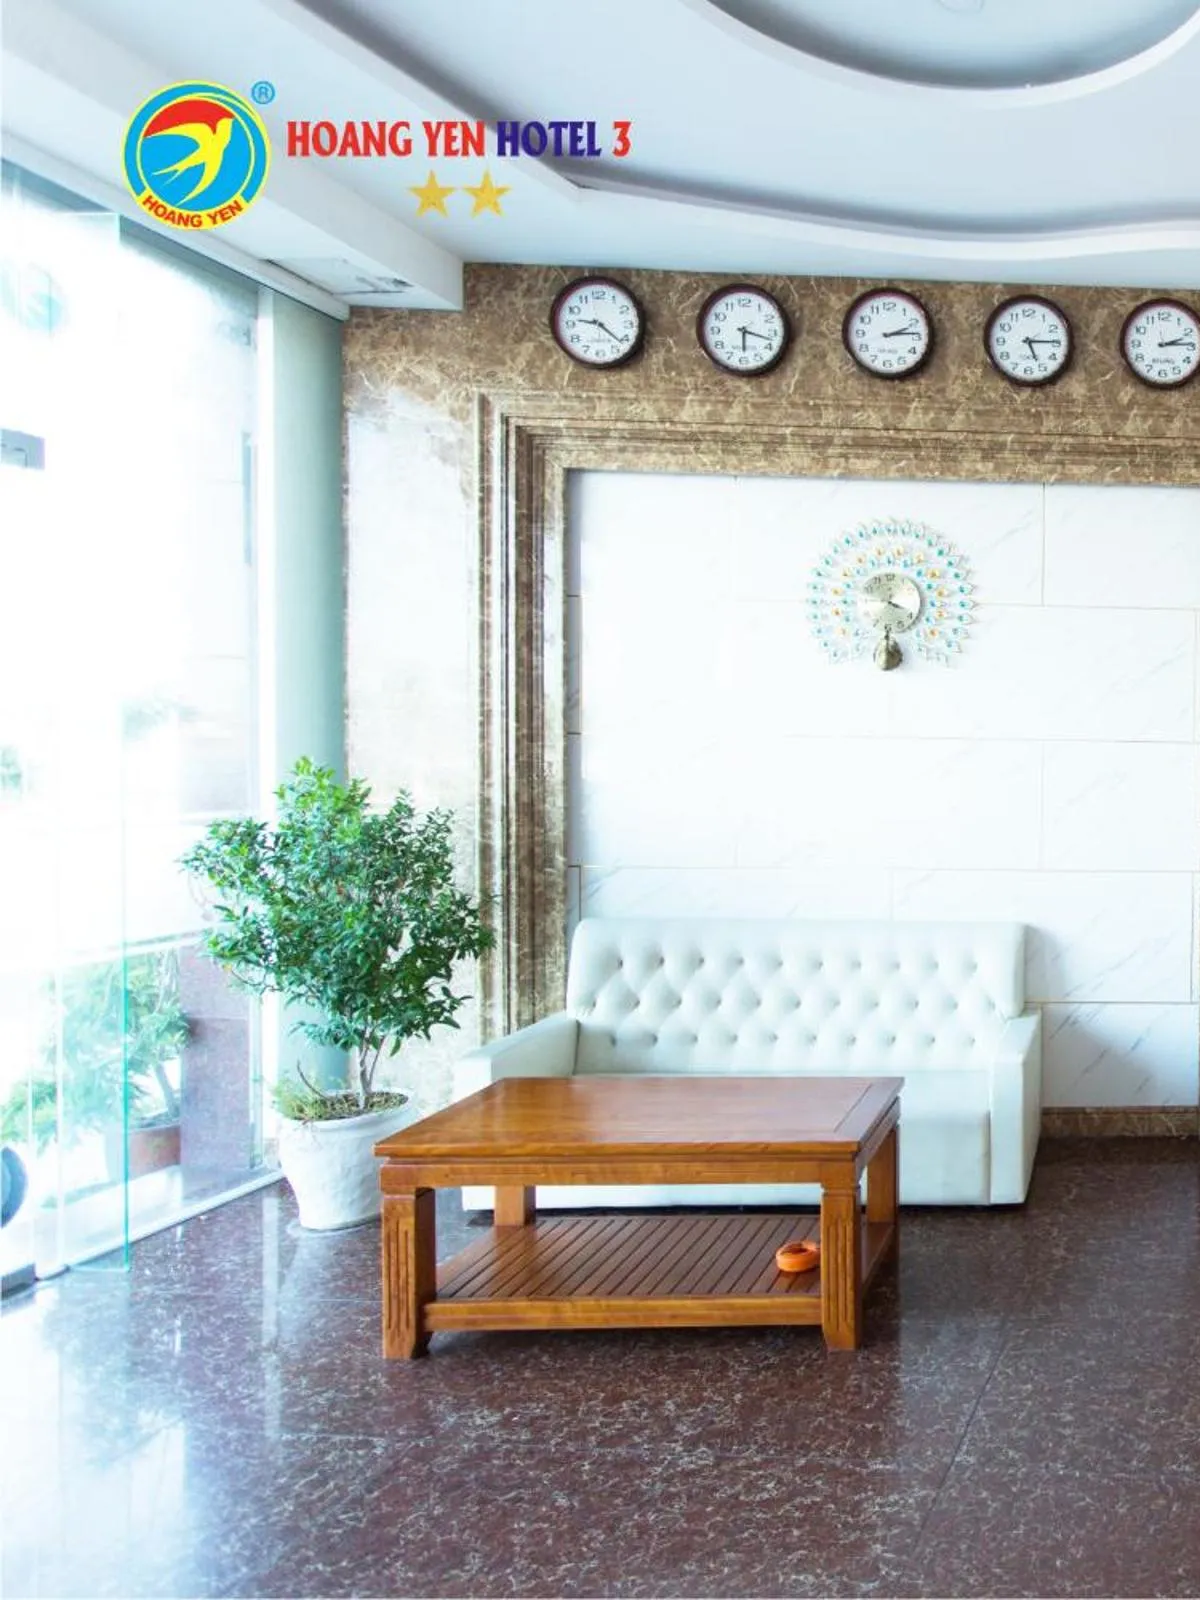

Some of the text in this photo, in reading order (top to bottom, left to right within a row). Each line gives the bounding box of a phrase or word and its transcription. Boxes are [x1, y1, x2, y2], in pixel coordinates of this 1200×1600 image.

[592, 290, 606, 299] 12
[580, 295, 587, 304] 11
[738, 298, 751, 307] 12
[569, 305, 581, 314] 10
[620, 305, 629, 314] 2
[726, 302, 733, 312] 11
[871, 305, 879, 314] 11
[883, 302, 896, 311] 12
[714, 312, 727, 321] 10
[1011, 313, 1018, 322] 11
[1022, 308, 1036, 319] 12
[1158, 311, 1171, 321] 12
[765, 314, 774, 323] 2
[860, 316, 871, 324] 10
[1147, 316, 1154, 324] 11
[566, 320, 575, 329] 9
[909, 319, 919, 327] 2
[711, 327, 720, 335] 9
[1000, 323, 1011, 332] 10
[1049, 325, 1058, 333] 2
[1136, 326, 1146, 335] 10
[856, 329, 865, 337] 9
[1184, 328, 1192, 336] 2
[571, 334, 580, 343] 8
[996, 337, 1005, 345] 9
[715, 341, 724, 349] 8
[765, 343, 772, 351] 4
[1132, 339, 1141, 348] 9
[582, 345, 590, 353] 7
[859, 344, 869, 352] 8
[908, 346, 916, 354] 4
[726, 352, 733, 360] 7
[870, 355, 877, 363] 7
[1000, 352, 1009, 360] 8
[1011, 362, 1018, 371] 7
[1039, 363, 1047, 371] 5
[1145, 365, 1153, 373] 7
[1173, 366, 1181, 374] 5
